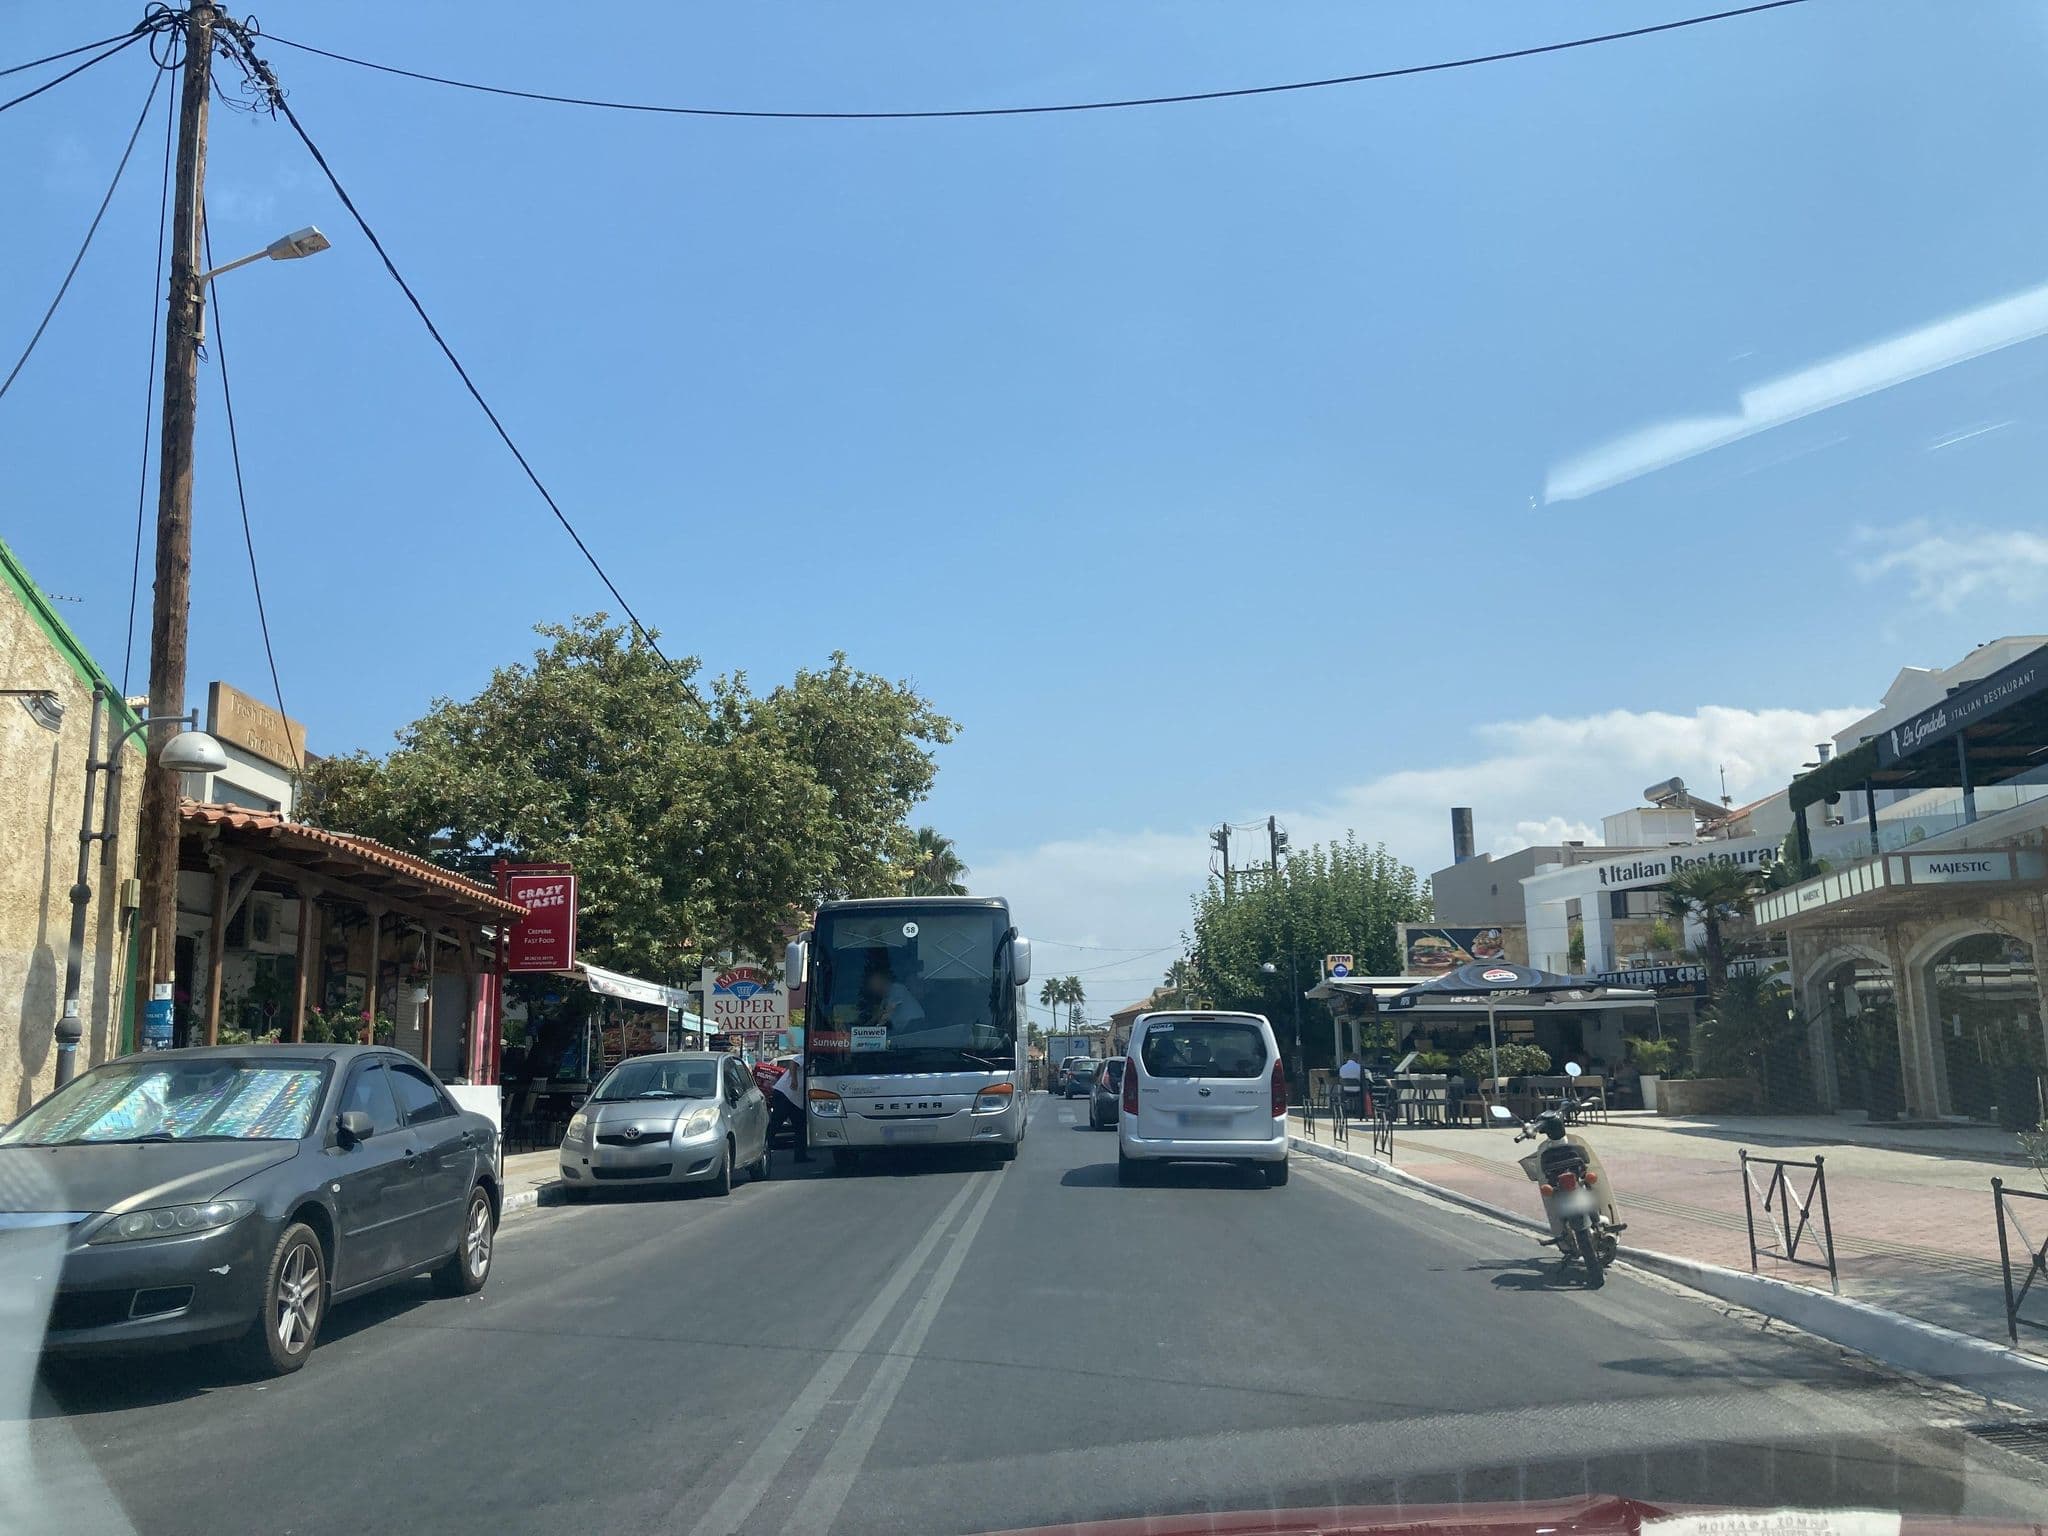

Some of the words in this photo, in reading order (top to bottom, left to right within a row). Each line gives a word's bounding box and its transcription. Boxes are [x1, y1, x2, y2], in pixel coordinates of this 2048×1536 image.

[1902, 726, 1914, 747] La
[1915, 709, 1947, 745] Gondola
[1950, 699, 1982, 721] ITALIAN
[1984, 669, 2035, 704] RESTAURANT
[1610, 862, 1667, 882] Italian
[1670, 845, 1778, 873] Restaura
[1929, 861, 1992, 875] MAJESTIC
[517, 884, 564, 900] CRAZY
[525, 895, 564, 909] TASTE
[906, 926, 915, 934] 58
[1330, 955, 1351, 963] ATM
[1490, 989, 1530, 998] PEPSI
[714, 999, 775, 1015] SUPER
[854, 1028, 886, 1037] Sunweb
[812, 1038, 850, 1048] Sunweb
[874, 1102, 943, 1111] SETRA
